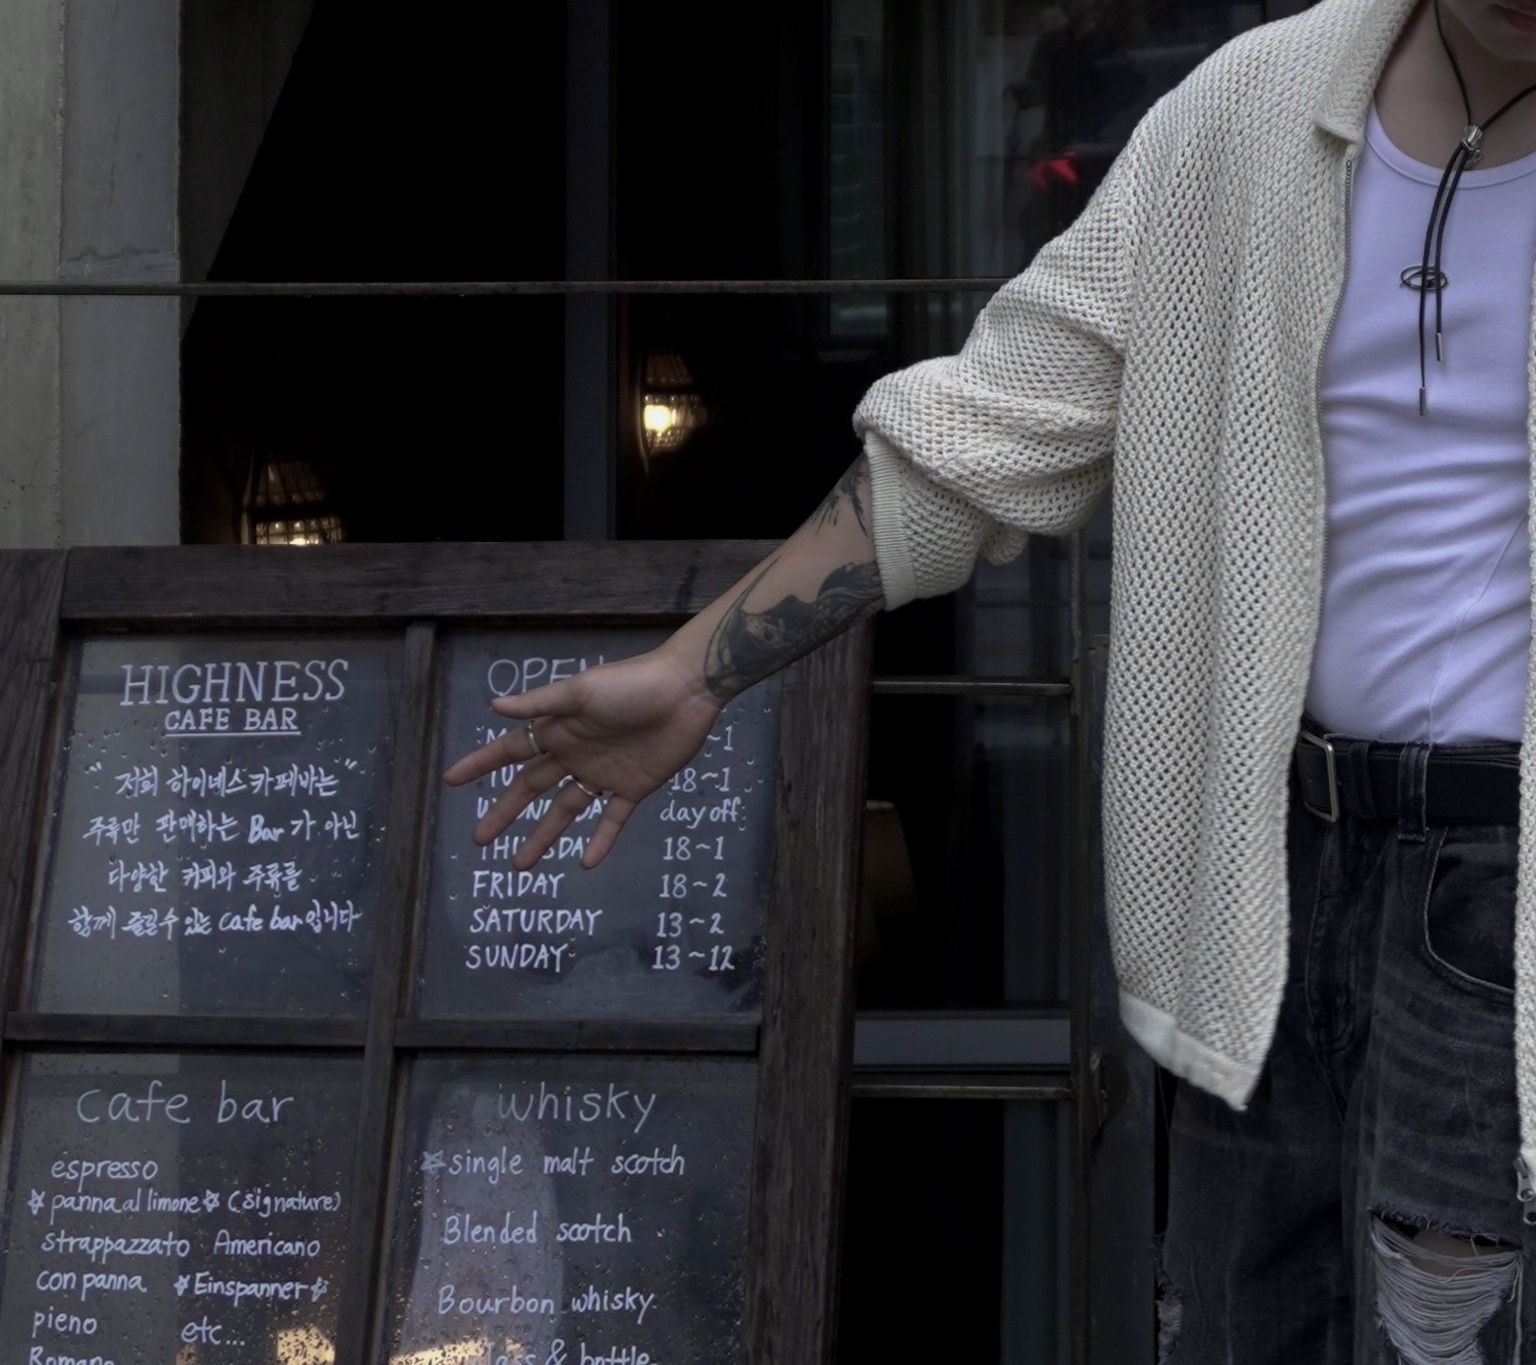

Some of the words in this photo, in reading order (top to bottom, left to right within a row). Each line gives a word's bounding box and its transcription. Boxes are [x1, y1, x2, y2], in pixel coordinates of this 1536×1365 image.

[120, 658, 349, 707] HIGHNESS
[164, 707, 230, 731] CAFE
[244, 707, 299, 731] BAR
[114, 764, 159, 798] 저희
[82, 811, 142, 846] 주류만
[155, 808, 240, 843] 판매하는
[324, 809, 360, 841] 아닌
[659, 800, 707, 829] day
[108, 858, 169, 893] 다양한
[181, 858, 237, 893] 커피와
[242, 860, 303, 892] 주류를
[473, 870, 565, 899] FRIDAY
[67, 904, 116, 940] 함께
[184, 906, 213, 936] 있는
[218, 903, 264, 932] cafe
[469, 907, 603, 936] SATURDAY
[465, 942, 569, 973] SUNDAY
[76, 1079, 191, 1125] cafe
[216, 1079, 294, 1124] bar
[498, 1081, 656, 1134] whisky
[51, 1158, 159, 1193] espresso
[448, 1145, 525, 1184] single
[543, 1146, 595, 1175] malt
[611, 1144, 685, 1176] scotch
[146, 1190, 201, 1213] limone
[213, 1229, 321, 1257] Americano
[444, 1211, 538, 1245] Blended
[556, 1212, 632, 1244] scotch
[41, 1229, 191, 1264] strappazzato
[36, 1269, 76, 1292] con
[81, 1271, 148, 1302] panna
[194, 1271, 310, 1307] Einspanner
[438, 1284, 555, 1316] Bourbon
[572, 1285, 655, 1324] whisky
[32, 1306, 98, 1338] pieno
